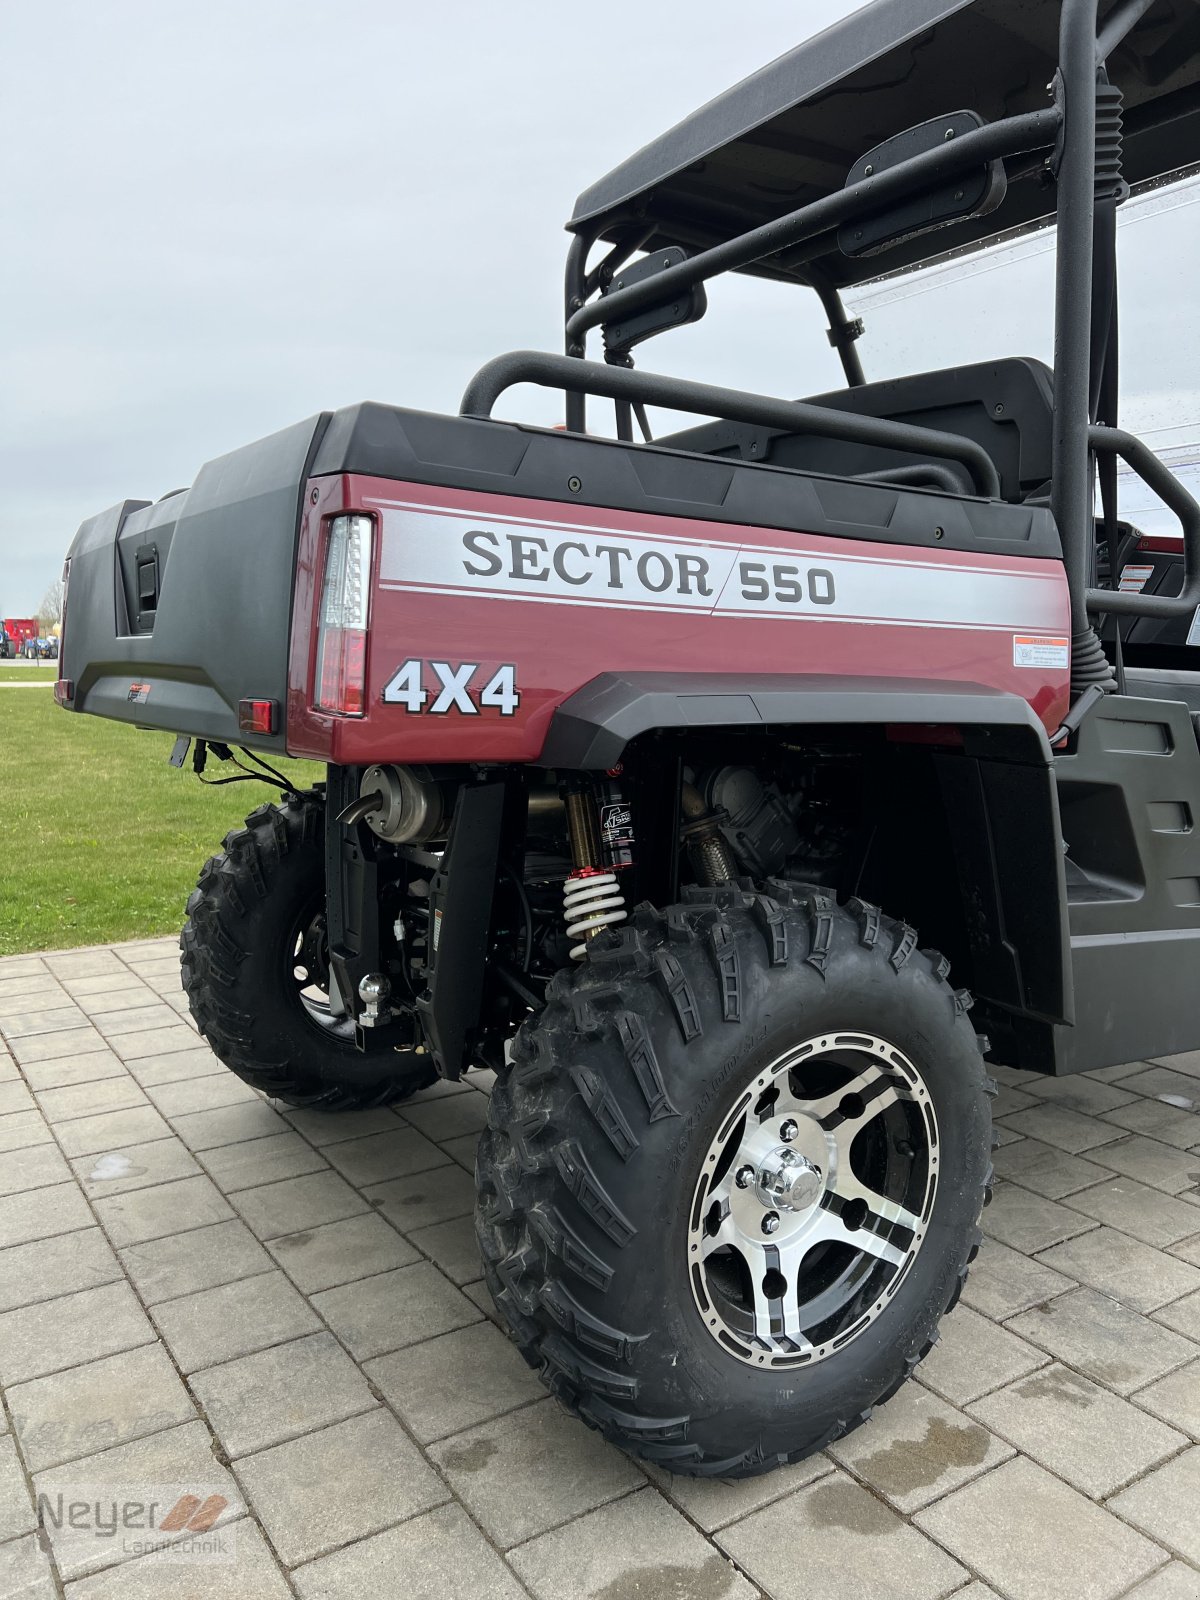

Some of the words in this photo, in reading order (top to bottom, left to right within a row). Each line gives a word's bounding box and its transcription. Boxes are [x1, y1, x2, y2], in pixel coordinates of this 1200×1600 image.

[462, 530, 713, 597] SECTOR
[739, 562, 836, 605] 550
[383, 658, 520, 715] 4X4
